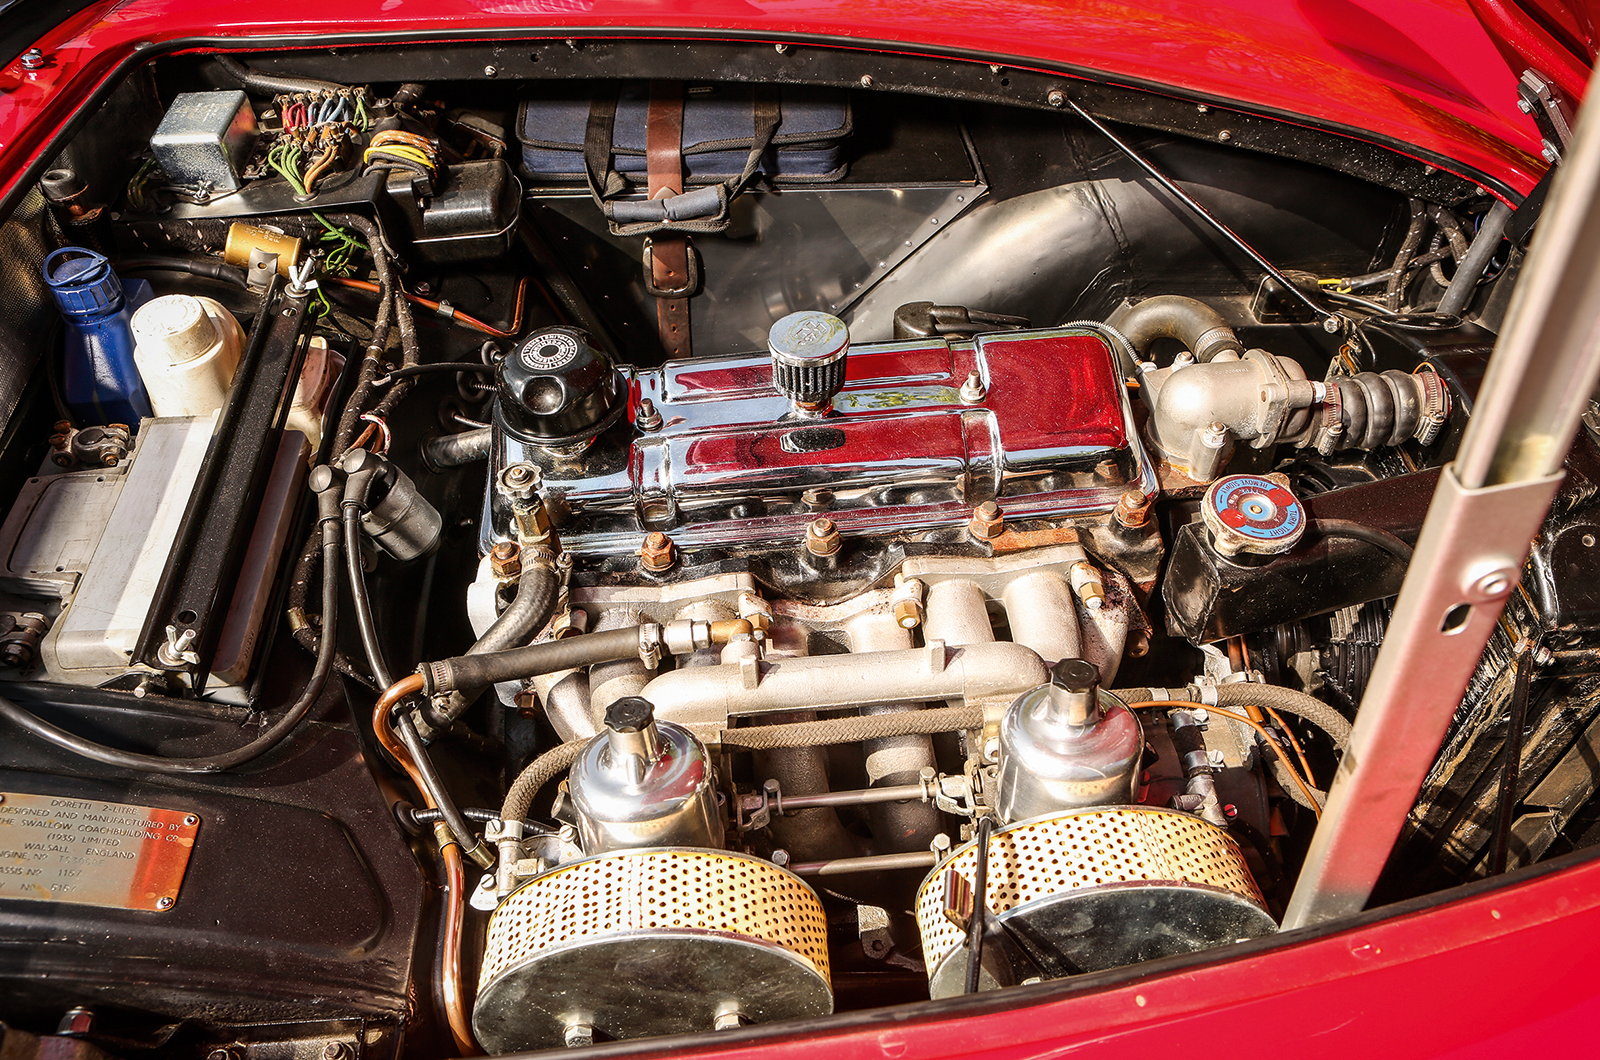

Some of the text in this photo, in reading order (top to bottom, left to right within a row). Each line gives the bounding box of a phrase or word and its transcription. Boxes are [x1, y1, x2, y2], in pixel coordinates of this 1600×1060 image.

[1221, 480, 1268, 494] REMOVE SLOWLY
[1269, 510, 1297, 537] TURN TIGHT
[51, 800, 92, 810] DORETTI
[1, 807, 181, 831] DESIGNED AND MANUFACTURED BY
[0, 817, 15, 825] HE
[21, 819, 72, 830] SWALLOW
[78, 825, 160, 840] COACHBUILDING
[47, 833, 120, 846] (1935) LIMITED
[24, 843, 135, 859] WALSALL ENGLAND
